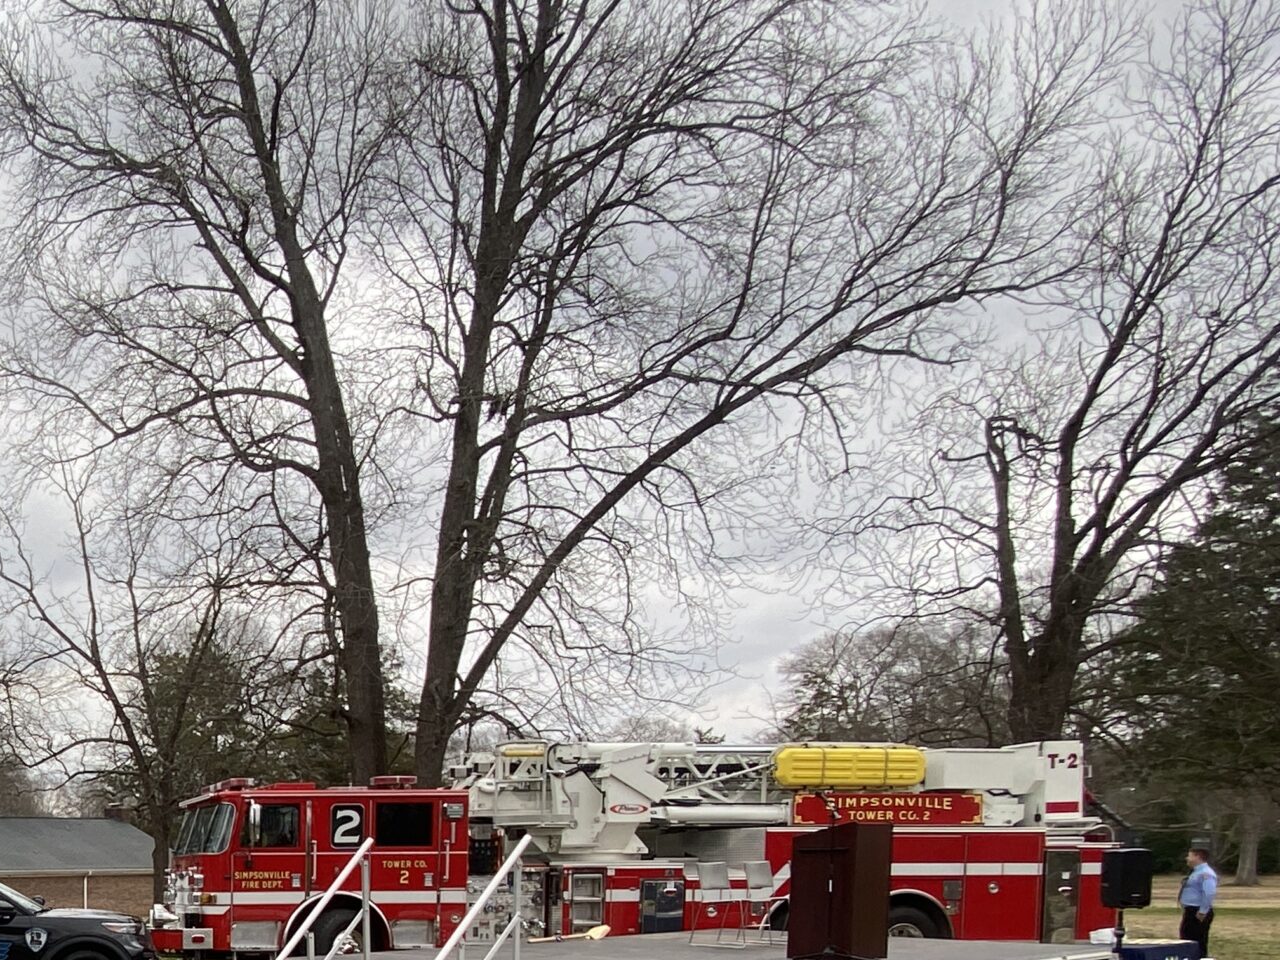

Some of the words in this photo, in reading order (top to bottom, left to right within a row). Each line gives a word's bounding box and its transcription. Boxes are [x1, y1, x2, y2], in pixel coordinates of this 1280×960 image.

[1047, 753, 1078, 769] T-2
[826, 797, 953, 810] SIMPSONVILLE
[848, 810, 894, 820] TOWER
[899, 810, 920, 820] CO.
[923, 810, 931, 820] 2
[333, 809, 361, 844] 2
[382, 860, 412, 869] TOWER
[414, 860, 428, 869] CO.
[234, 871, 291, 880] SIMPSONVILLE
[399, 870, 410, 884] 2
[241, 880, 260, 889] FIRE
[262, 880, 284, 889] DEPT.
